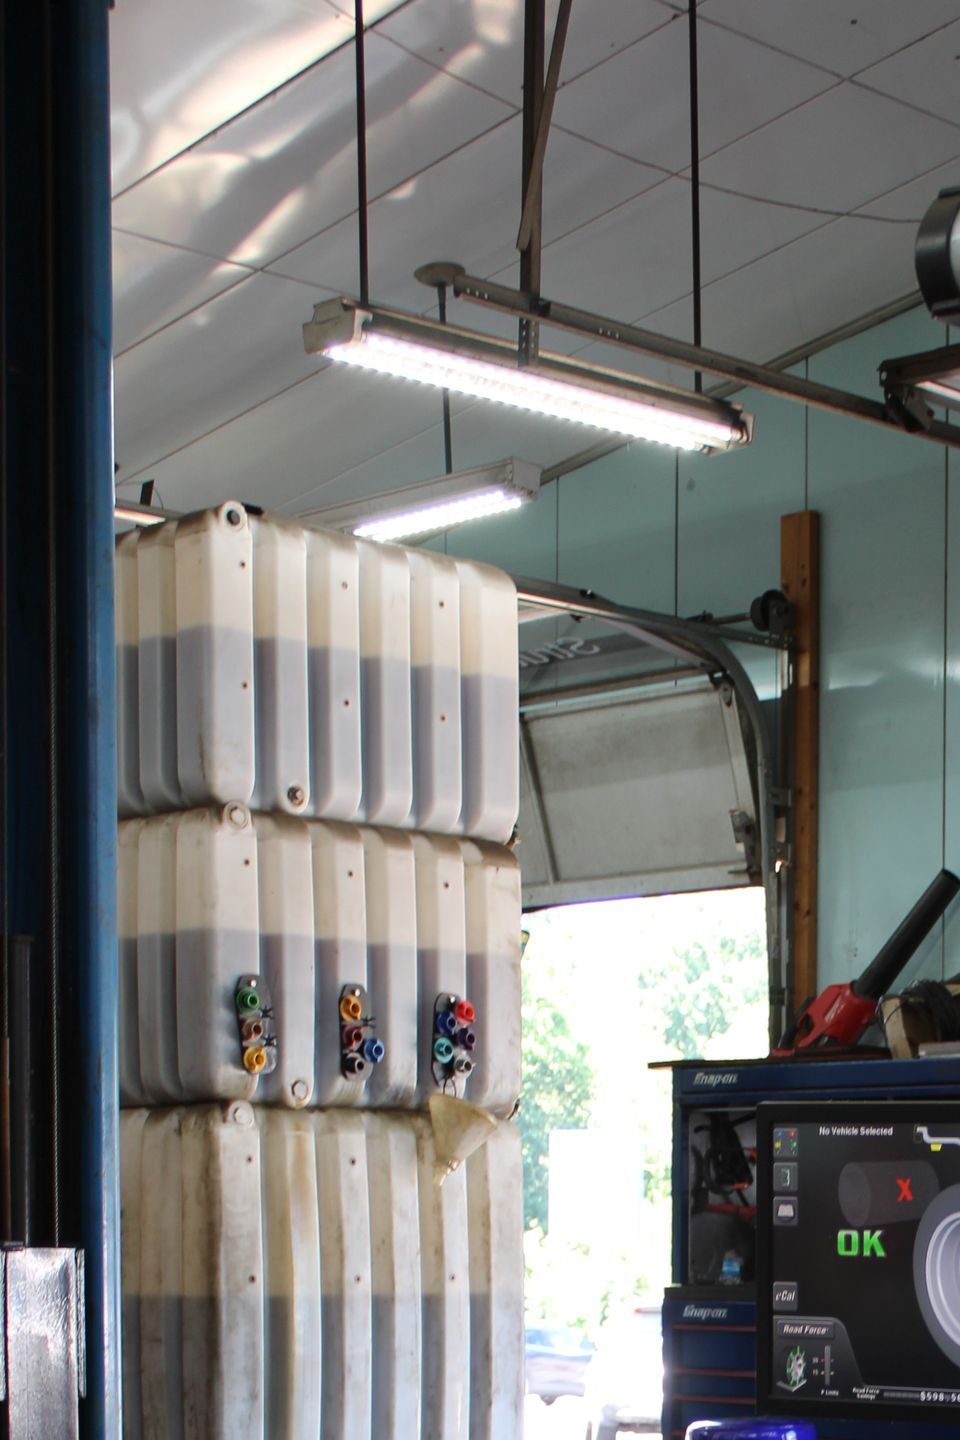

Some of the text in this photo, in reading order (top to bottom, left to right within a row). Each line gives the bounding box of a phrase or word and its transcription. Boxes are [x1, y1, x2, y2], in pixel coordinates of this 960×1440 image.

[819, 1126, 893, 1137] No Vehicle Selected
[836, 1229, 887, 1258] OK
[783, 1323, 827, 1335] Road Force
